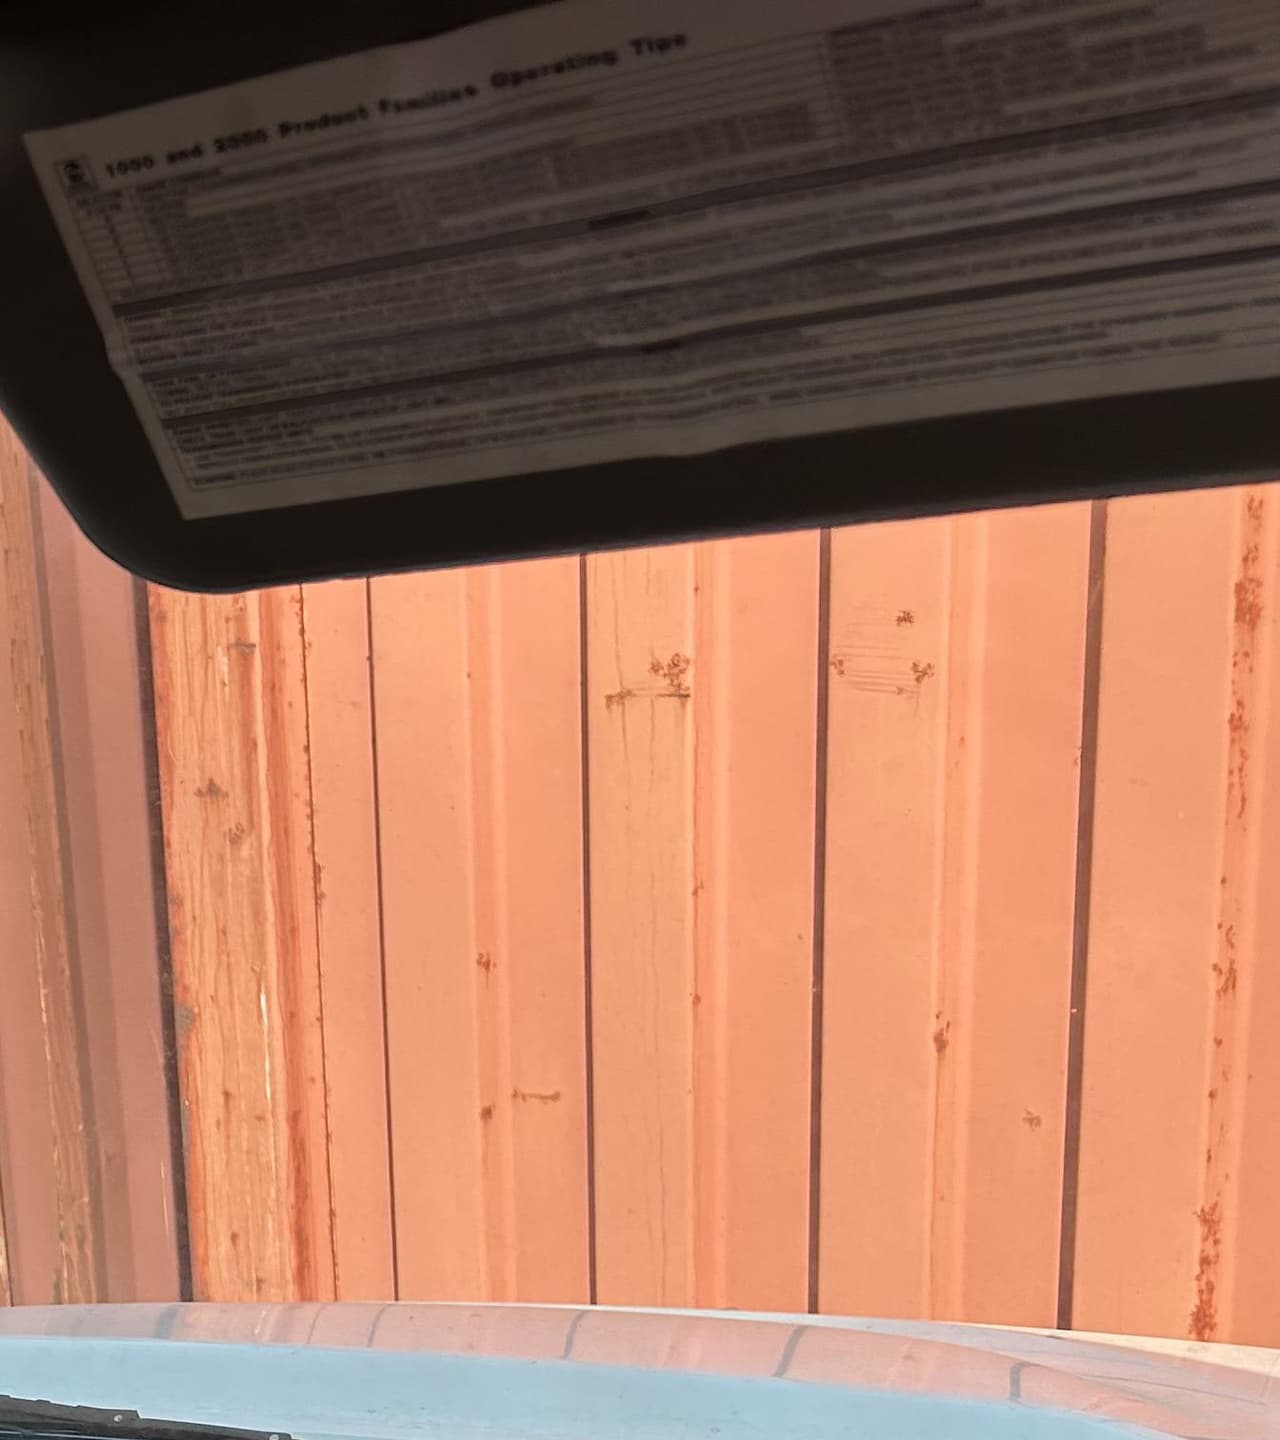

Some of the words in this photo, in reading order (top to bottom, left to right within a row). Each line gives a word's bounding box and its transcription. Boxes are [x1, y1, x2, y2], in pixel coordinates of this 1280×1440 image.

[279, 104, 371, 138] Product
[378, 81, 480, 117] Families
[489, 46, 619, 91] Operating
[628, 31, 690, 58] Tips
